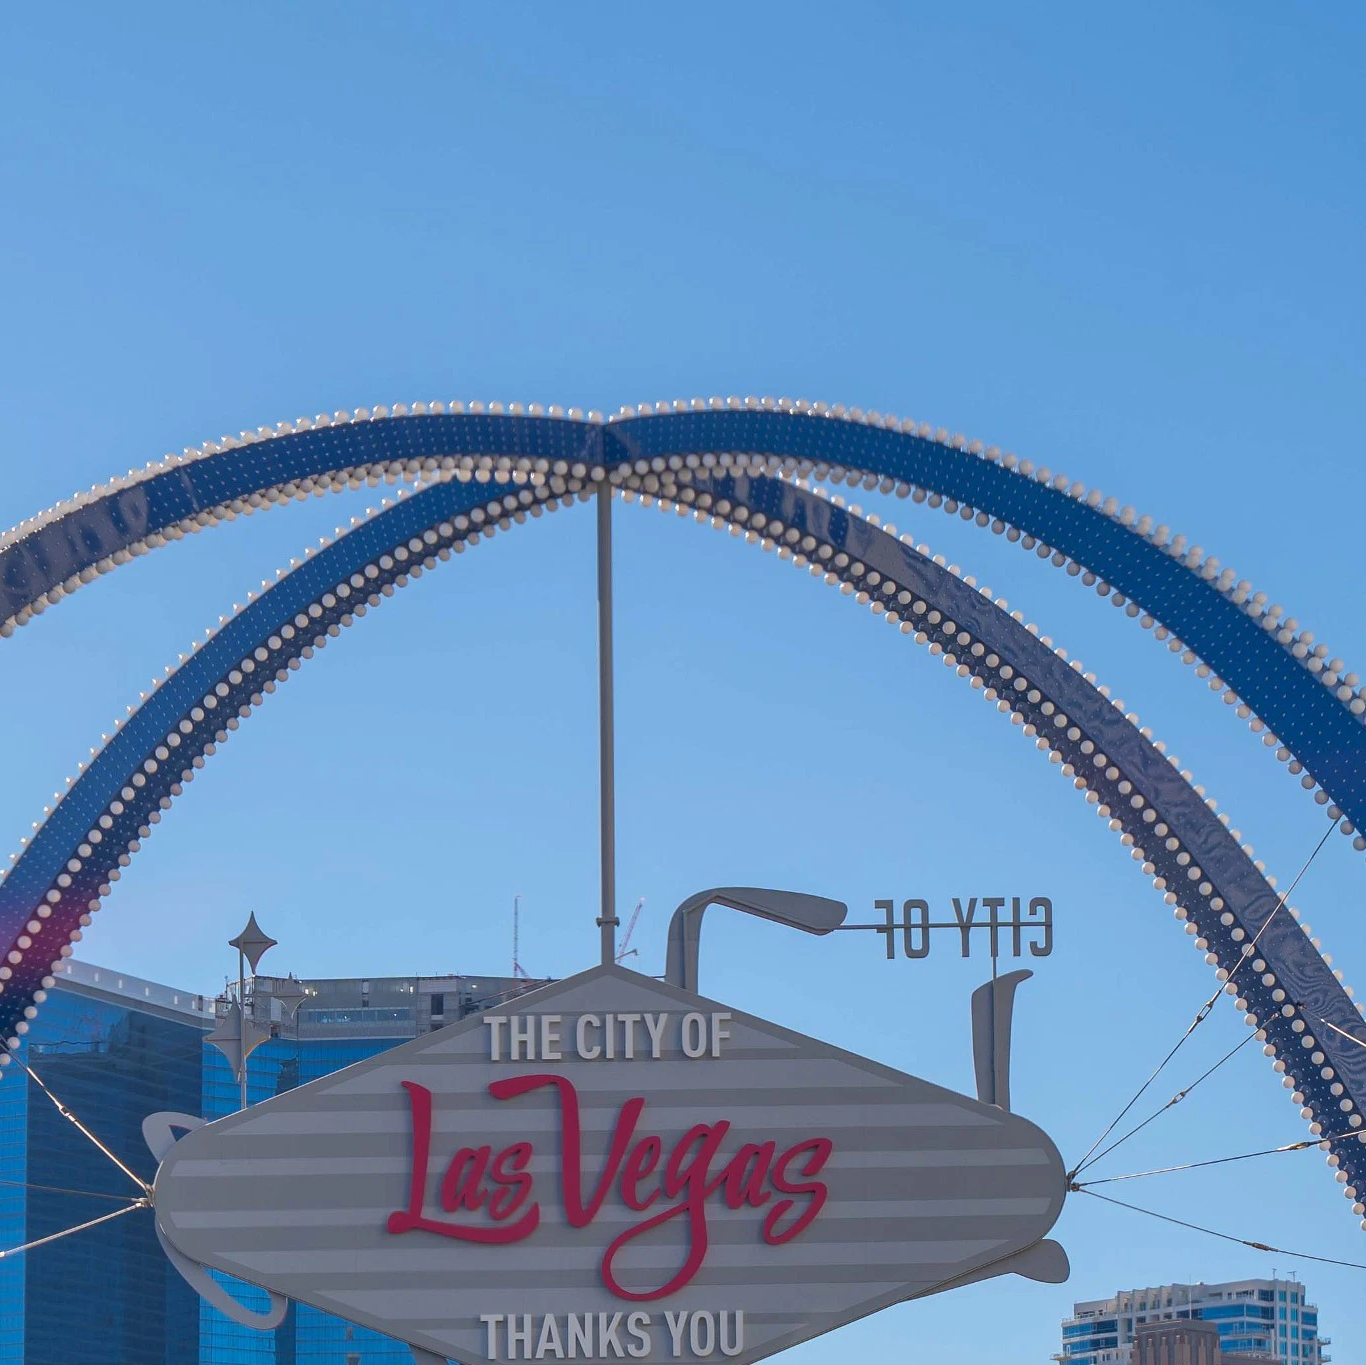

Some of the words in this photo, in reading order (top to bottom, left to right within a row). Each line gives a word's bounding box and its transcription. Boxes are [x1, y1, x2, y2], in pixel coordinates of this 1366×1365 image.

[483, 1014, 562, 1062] THE
[575, 1013, 668, 1060] CITY
[681, 1012, 732, 1059] OF
[387, 1080, 540, 1244] Las
[488, 1074, 833, 1302] Vegas
[480, 1311, 652, 1361] THANKS
[664, 1310, 745, 1359] YOU
